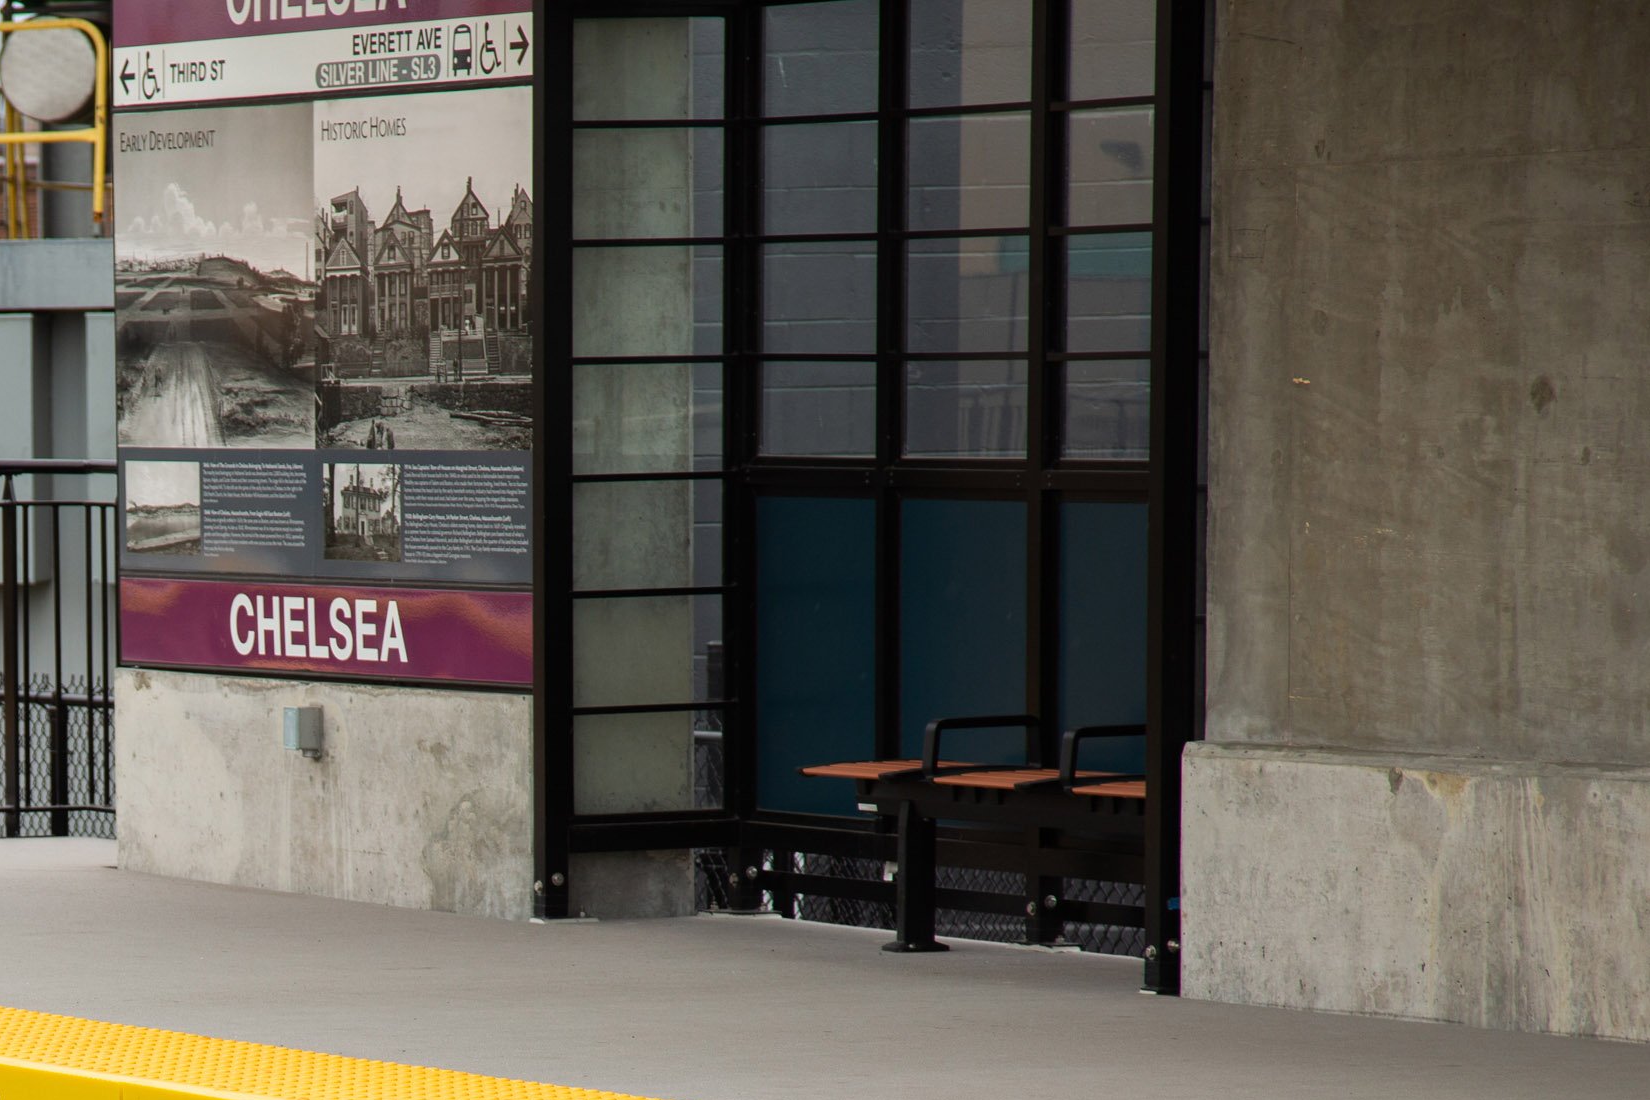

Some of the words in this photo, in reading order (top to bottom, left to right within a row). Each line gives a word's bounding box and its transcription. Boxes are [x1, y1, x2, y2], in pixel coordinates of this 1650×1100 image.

[353, 30, 412, 56] EVERETT
[416, 27, 442, 51] AVE
[170, 61, 207, 83] THIRD
[210, 60, 225, 81] ST
[320, 61, 364, 87] SILVER
[369, 59, 399, 82] LINE
[411, 56, 436, 80] SL3
[230, 593, 408, 662] CHELSEA
